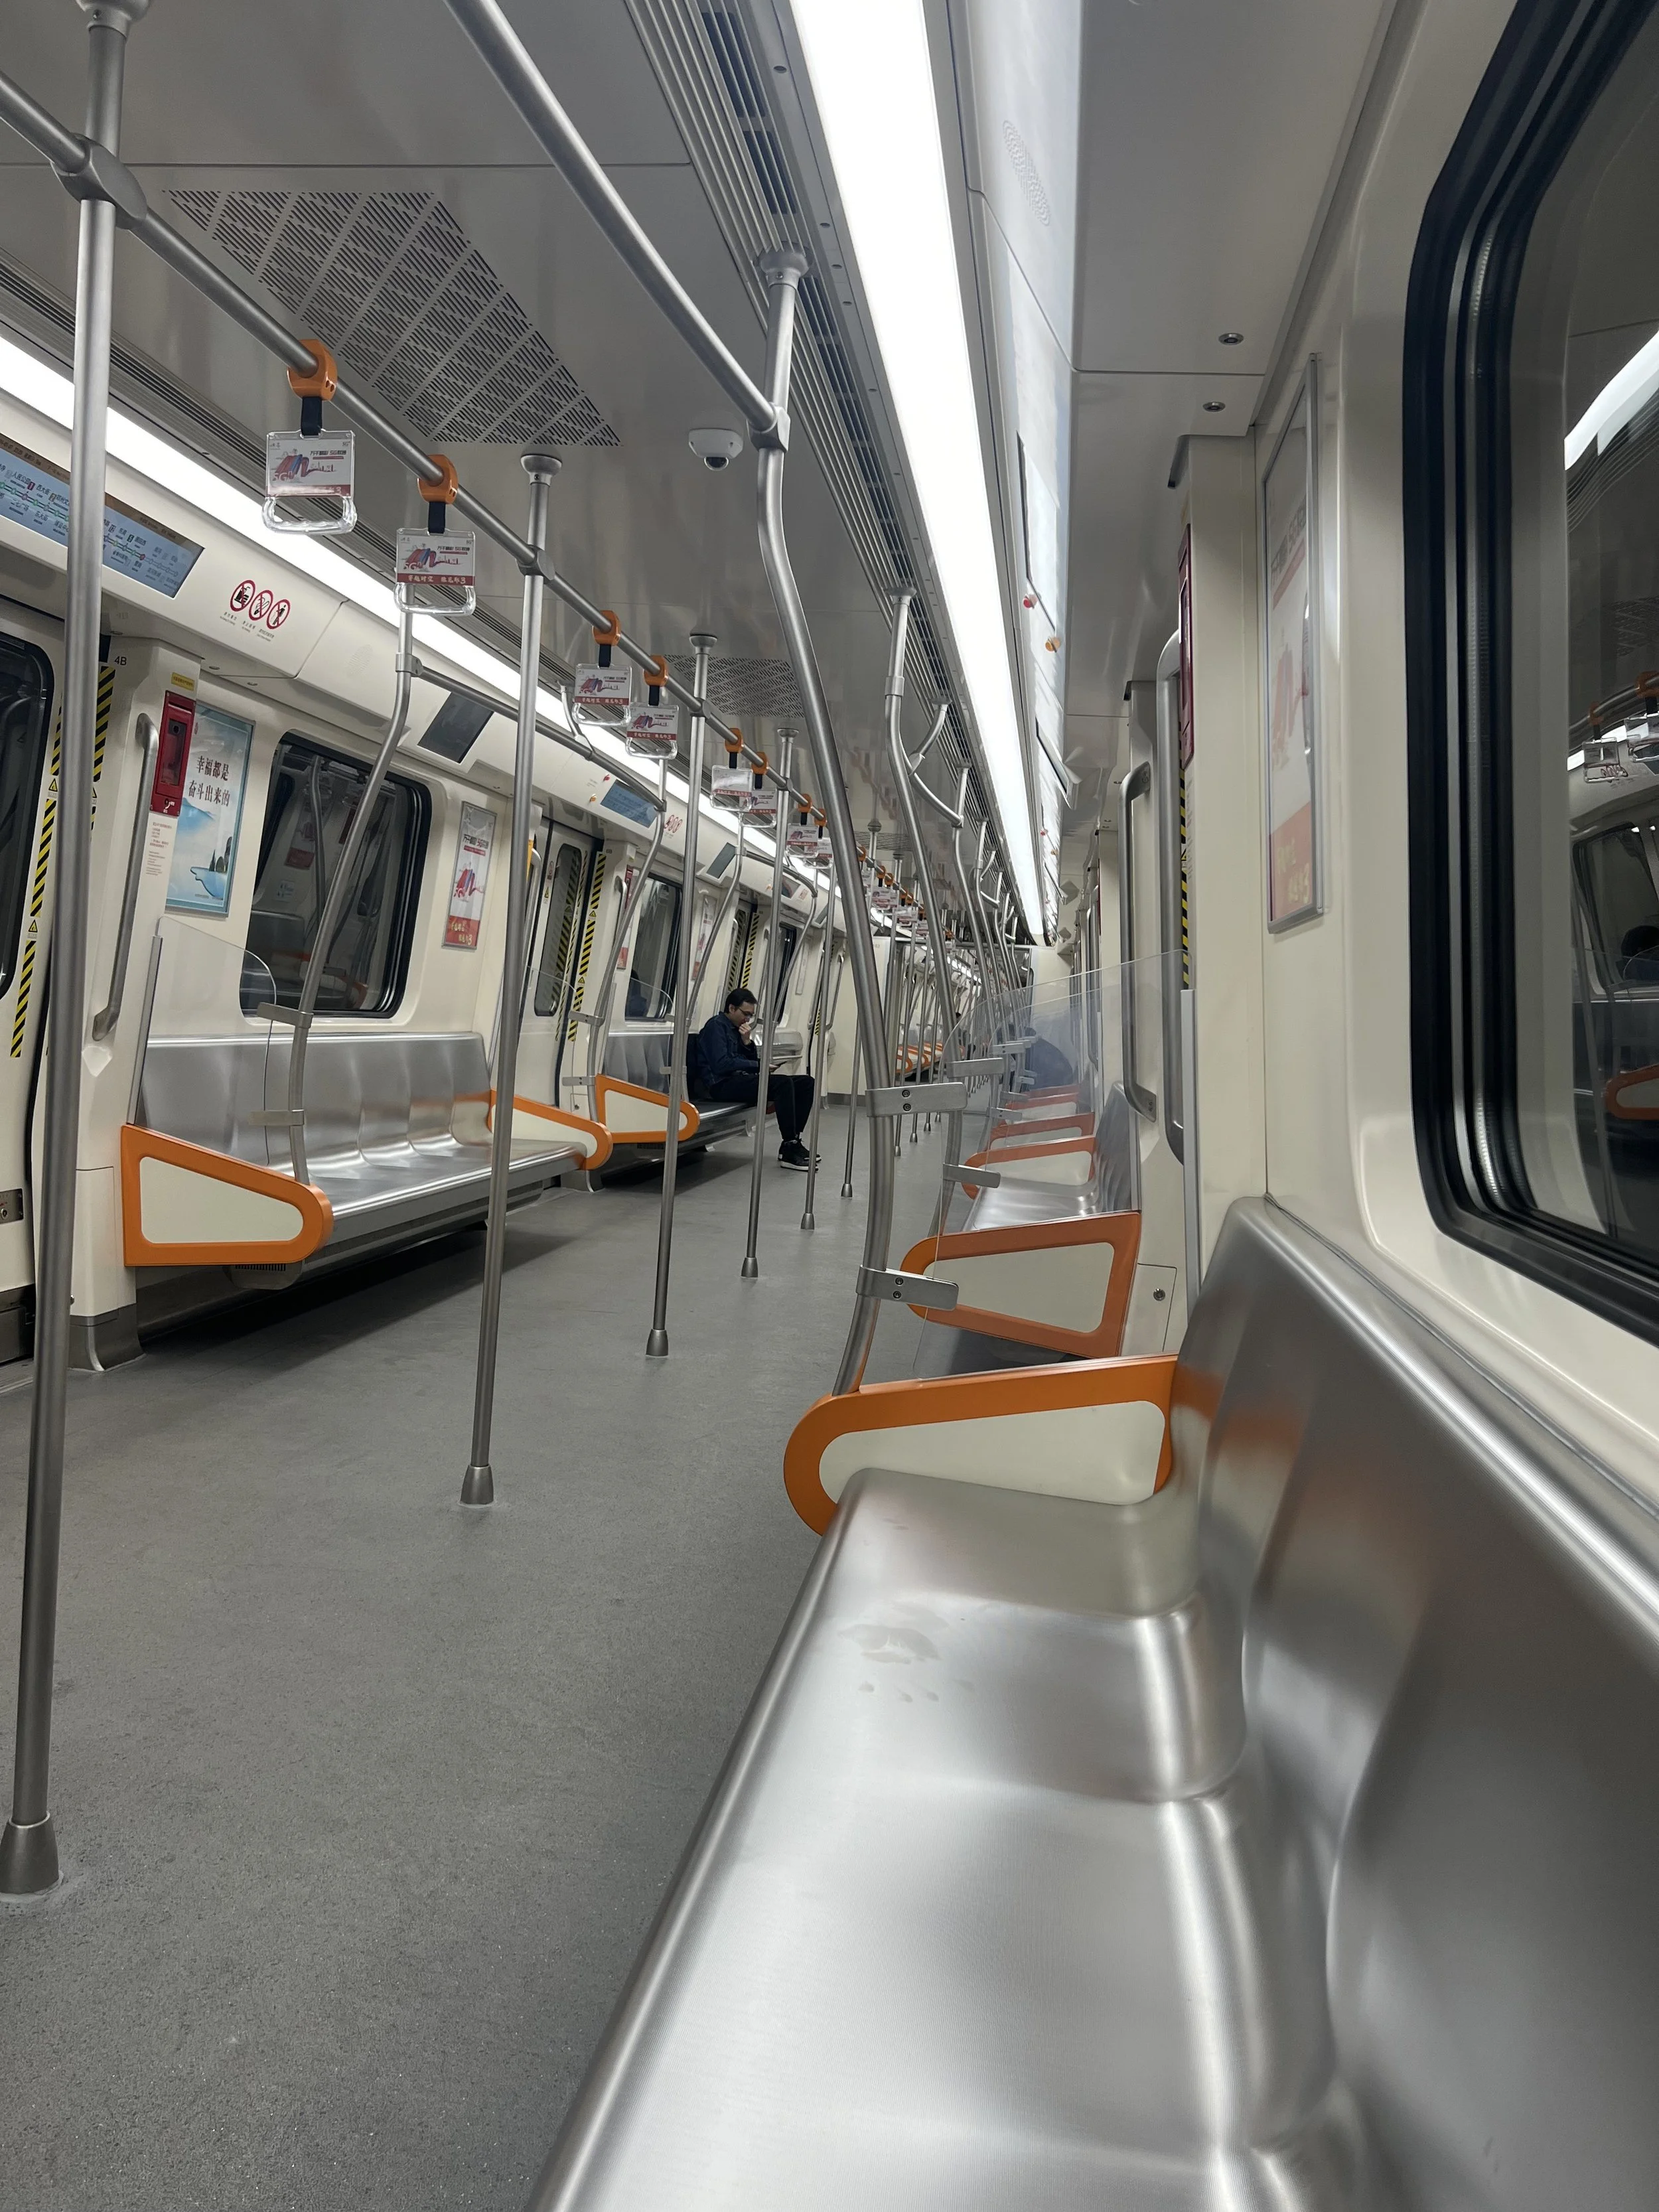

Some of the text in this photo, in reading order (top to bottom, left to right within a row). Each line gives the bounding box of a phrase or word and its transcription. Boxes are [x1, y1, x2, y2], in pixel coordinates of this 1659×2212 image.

[36, 484, 51, 495] 西大街
[114, 656, 127, 666] 4B
[196, 755, 229, 781] 幸福都是
[188, 780, 230, 807] 奋斗出来的
